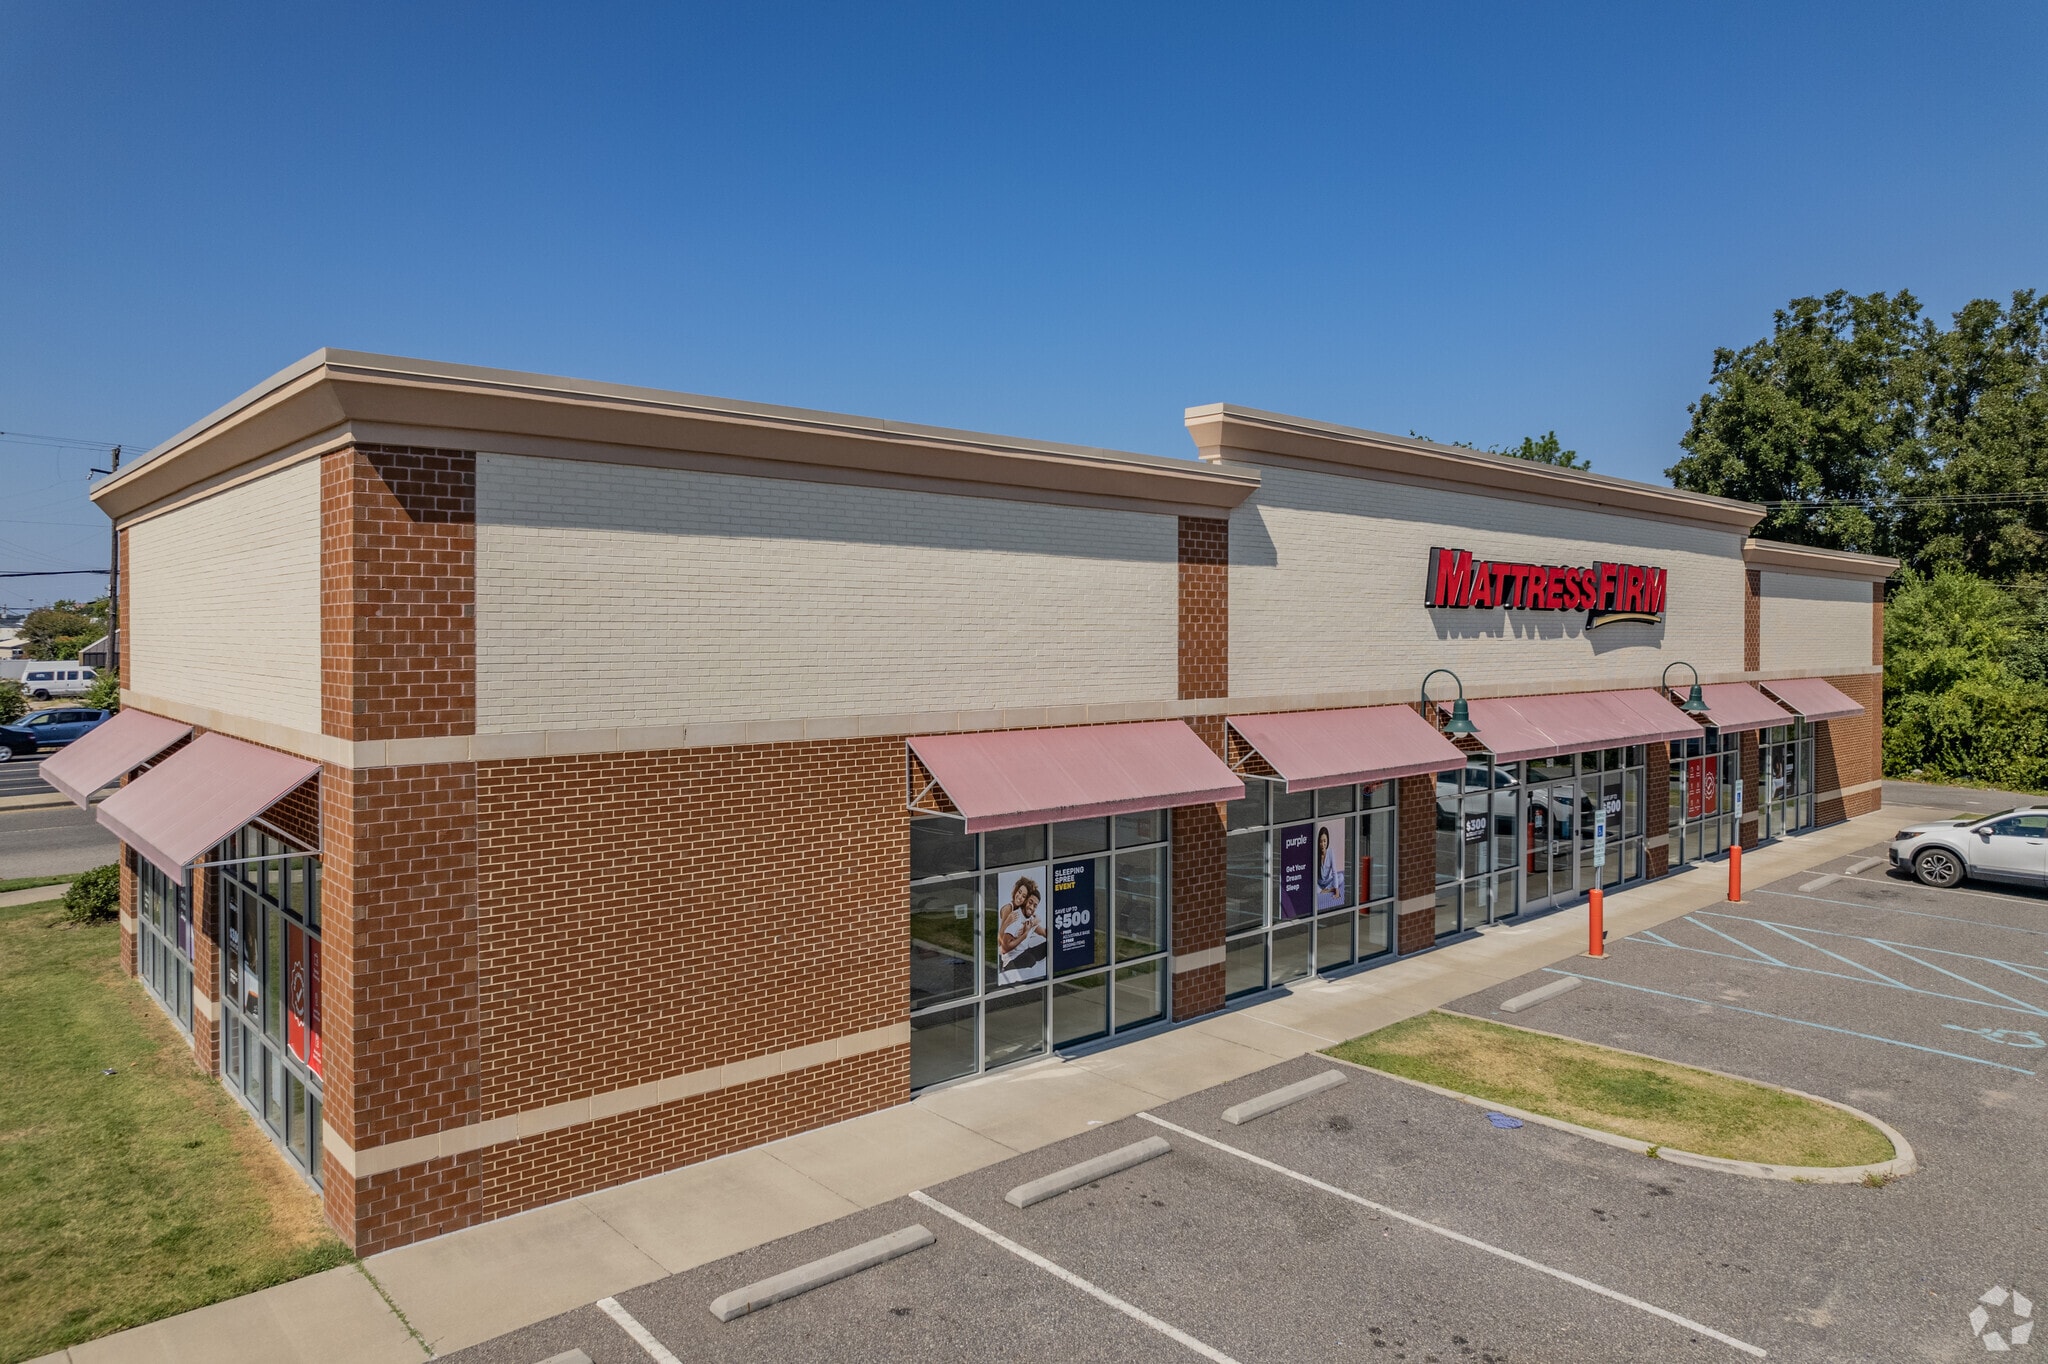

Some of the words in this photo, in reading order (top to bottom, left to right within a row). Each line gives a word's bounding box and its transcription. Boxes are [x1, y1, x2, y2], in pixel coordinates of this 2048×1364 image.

[1466, 817, 1486, 832] $300
[1286, 835, 1307, 849] purple
[1055, 866, 1085, 876] SLEEPING
[1286, 865, 1295, 873] Get
[1055, 875, 1075, 884] SPREE
[1286, 874, 1302, 882] Dream
[1055, 882, 1075, 891] EVENT
[1286, 884, 1300, 892] Sleep
[1055, 909, 1090, 930] $500
